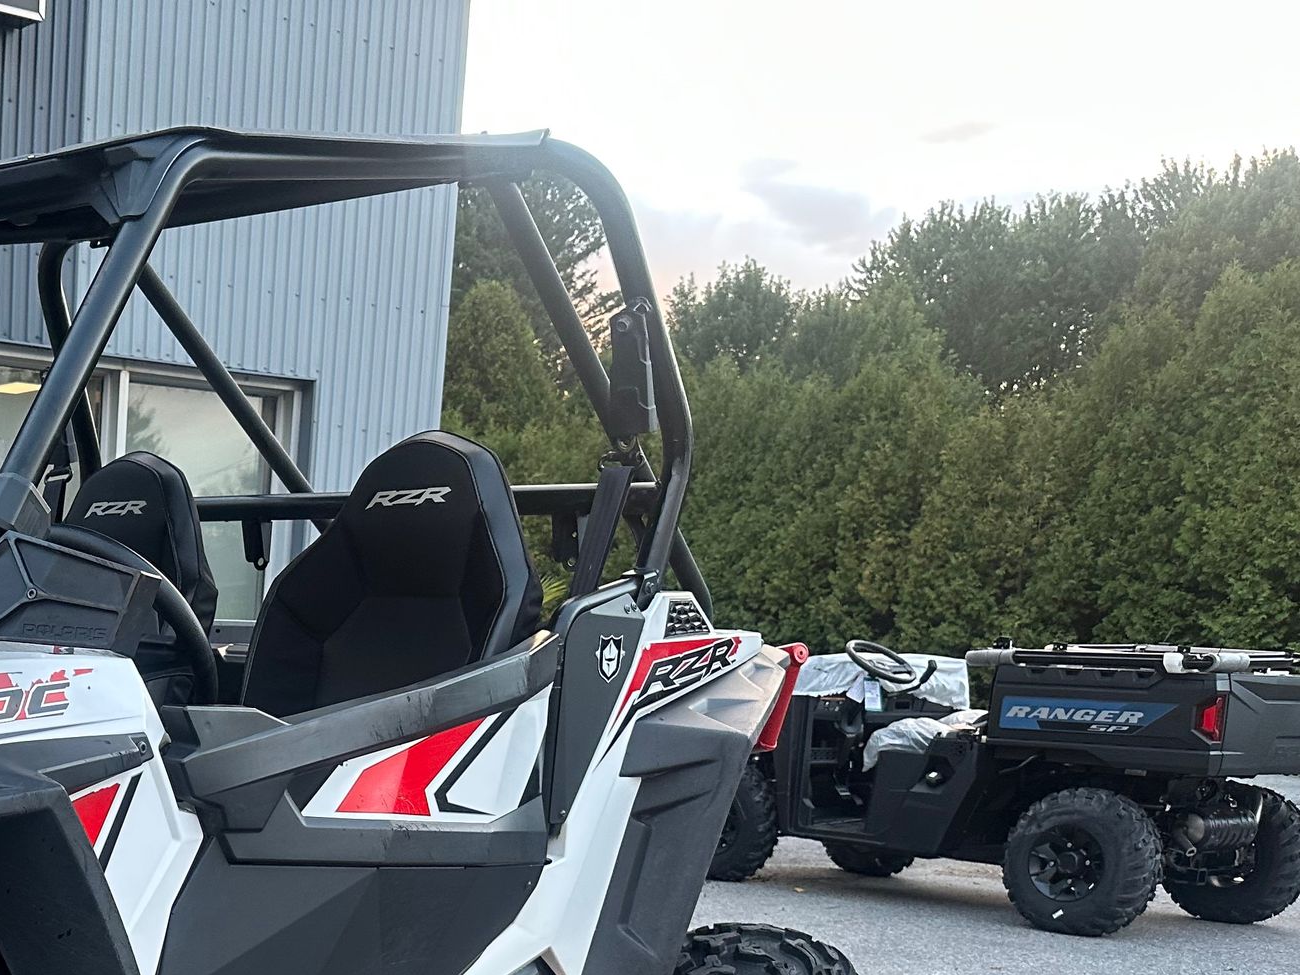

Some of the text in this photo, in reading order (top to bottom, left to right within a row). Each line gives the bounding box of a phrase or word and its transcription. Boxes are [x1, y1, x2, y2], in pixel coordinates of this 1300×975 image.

[364, 485, 452, 511] RZR
[83, 499, 148, 520] RZR
[21, 623, 108, 641] POLARIS
[634, 636, 737, 705] RZR
[1004, 705, 1145, 725] RANGER
[1086, 723, 1130, 733] SP
